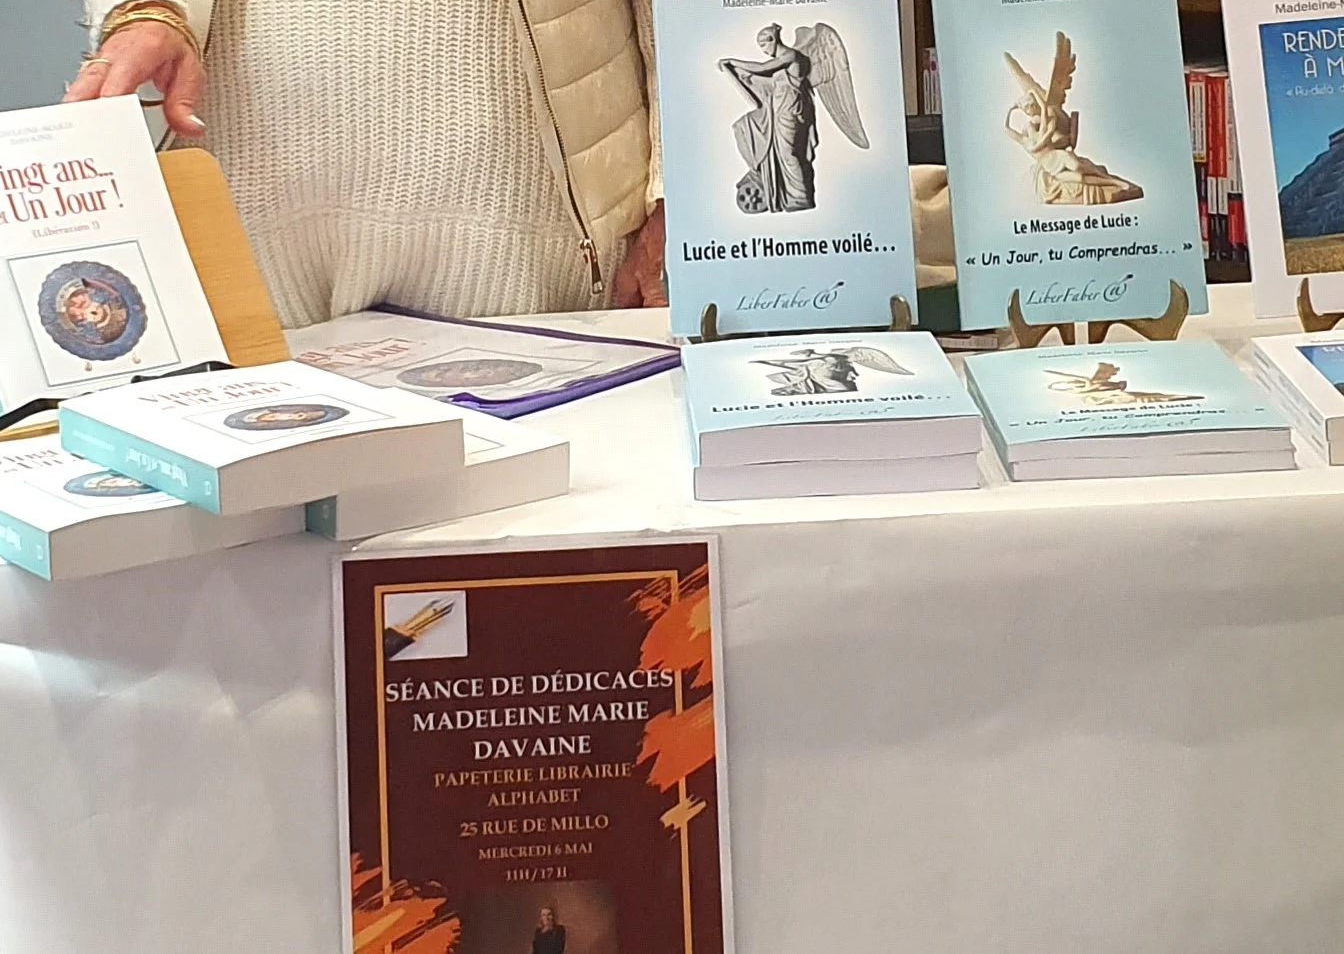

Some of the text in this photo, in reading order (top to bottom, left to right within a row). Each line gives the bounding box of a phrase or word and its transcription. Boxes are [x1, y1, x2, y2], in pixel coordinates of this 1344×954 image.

[1304, 54, 1318, 78] À
[57, 153, 114, 179] ans...
[8, 194, 51, 223] Un
[56, 185, 108, 217] Jour
[1014, 220, 1028, 236] Le
[1030, 217, 1083, 236] Message
[1084, 214, 1099, 230] de
[1101, 213, 1131, 229] Lucie
[683, 233, 897, 262] Lucie et l'Homme voilé...
[981, 252, 1000, 267] Un
[1006, 248, 1044, 265] Jour,
[1048, 246, 1063, 262] tu
[1068, 239, 1177, 263] Comprendras...
[385, 667, 674, 703] SÉANCE DE DÉDICACES
[412, 700, 650, 733] MADELEINE MARIE
[473, 735, 592, 762] DAVAINE
[433, 763, 632, 789] PAPETERIE LIBRAIRIE
[487, 788, 582, 808] ALPHABET
[459, 814, 610, 838] 25 RUE DE MILLO
[478, 845, 553, 860] MERCREDI
[565, 842, 593, 855] MAI
